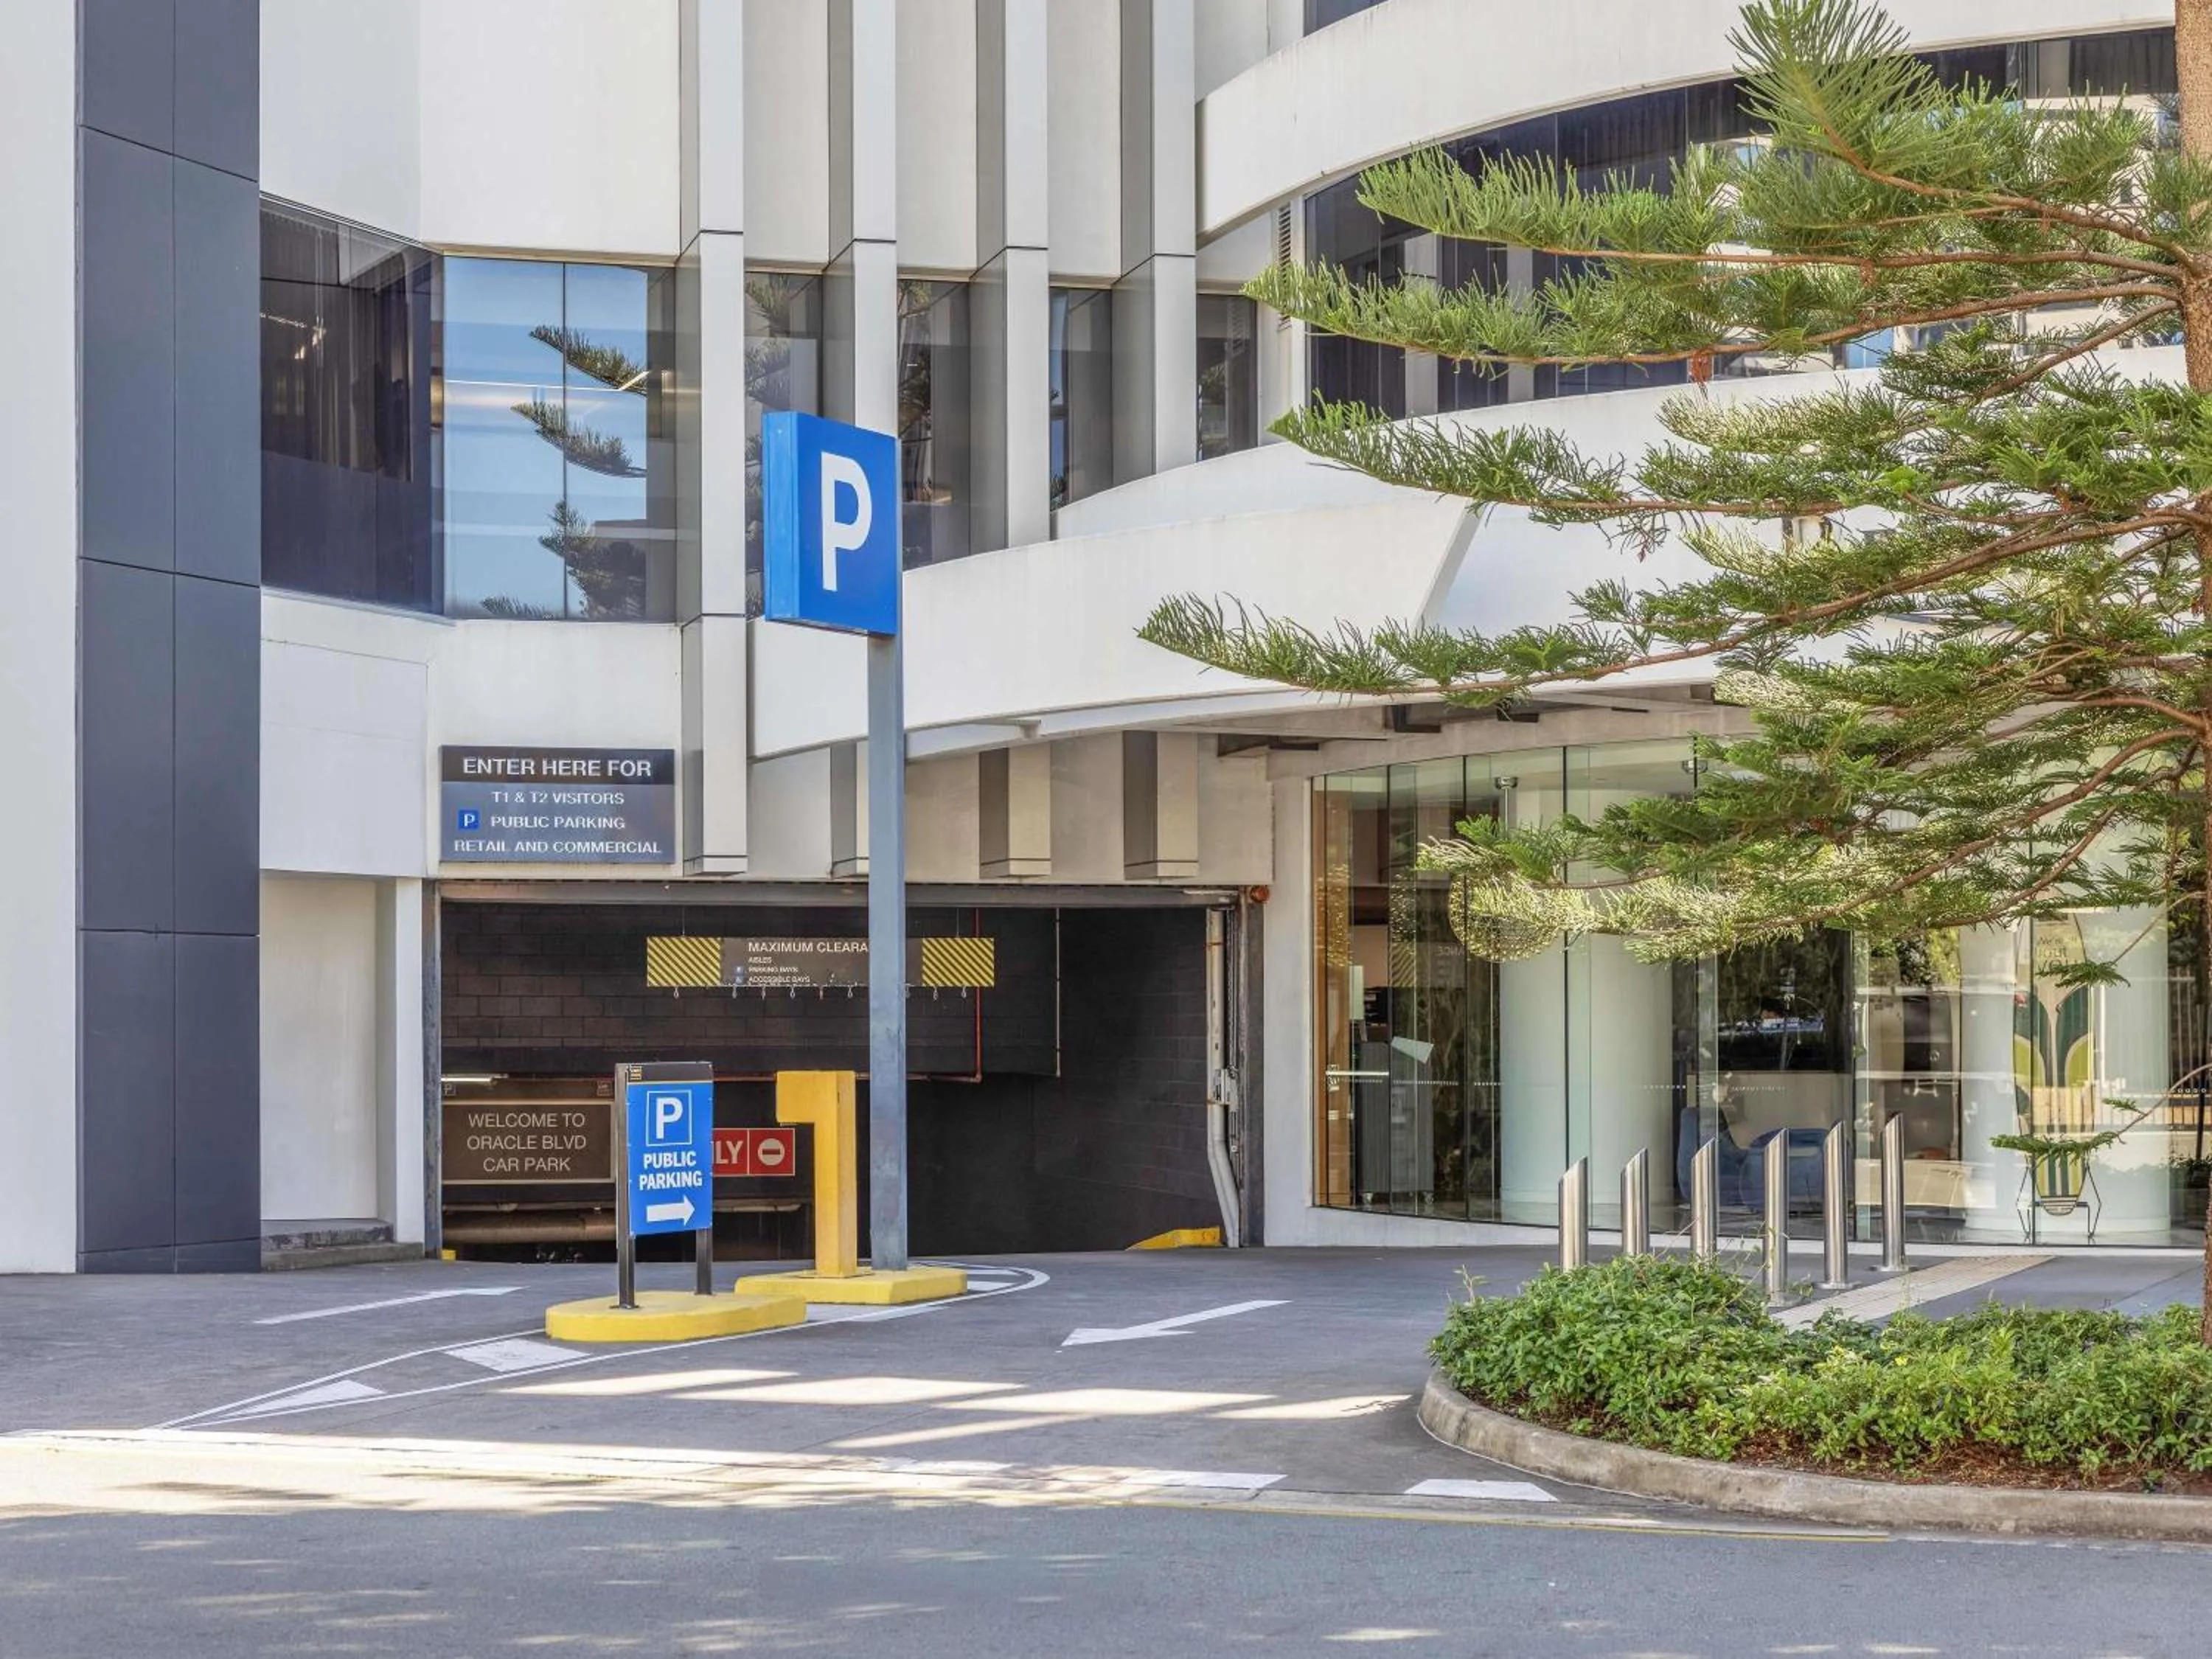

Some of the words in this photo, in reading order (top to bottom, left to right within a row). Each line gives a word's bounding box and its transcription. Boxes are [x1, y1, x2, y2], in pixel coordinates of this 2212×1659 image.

[821, 451, 872, 591] P
[462, 757, 535, 775] ENTER
[542, 759, 601, 776] HERE
[607, 759, 652, 777] FOR
[491, 791, 509, 803] T1
[515, 791, 525, 803] &
[530, 792, 548, 804] T2
[552, 793, 625, 804] VISITORS
[464, 814, 476, 827] P
[491, 815, 549, 828] PUBLIC
[554, 817, 626, 830] PARKING
[454, 840, 507, 852] RETAIL
[515, 841, 549, 853] AND
[553, 841, 661, 854] COMMERCIAL
[748, 942, 813, 953] MAXIMUM
[816, 942, 869, 953] CLEARA
[468, 1113, 557, 1128] WELCOME
[562, 1113, 585, 1128] TO
[655, 1096, 683, 1139] P
[467, 1135, 538, 1150] ORACLE
[542, 1135, 587, 1150] BLVD
[643, 1150, 697, 1170] PUBLIC
[712, 1141, 743, 1164] LY
[483, 1157, 519, 1172] CAR
[524, 1157, 571, 1172] PARK
[639, 1170, 703, 1191] PARKING
